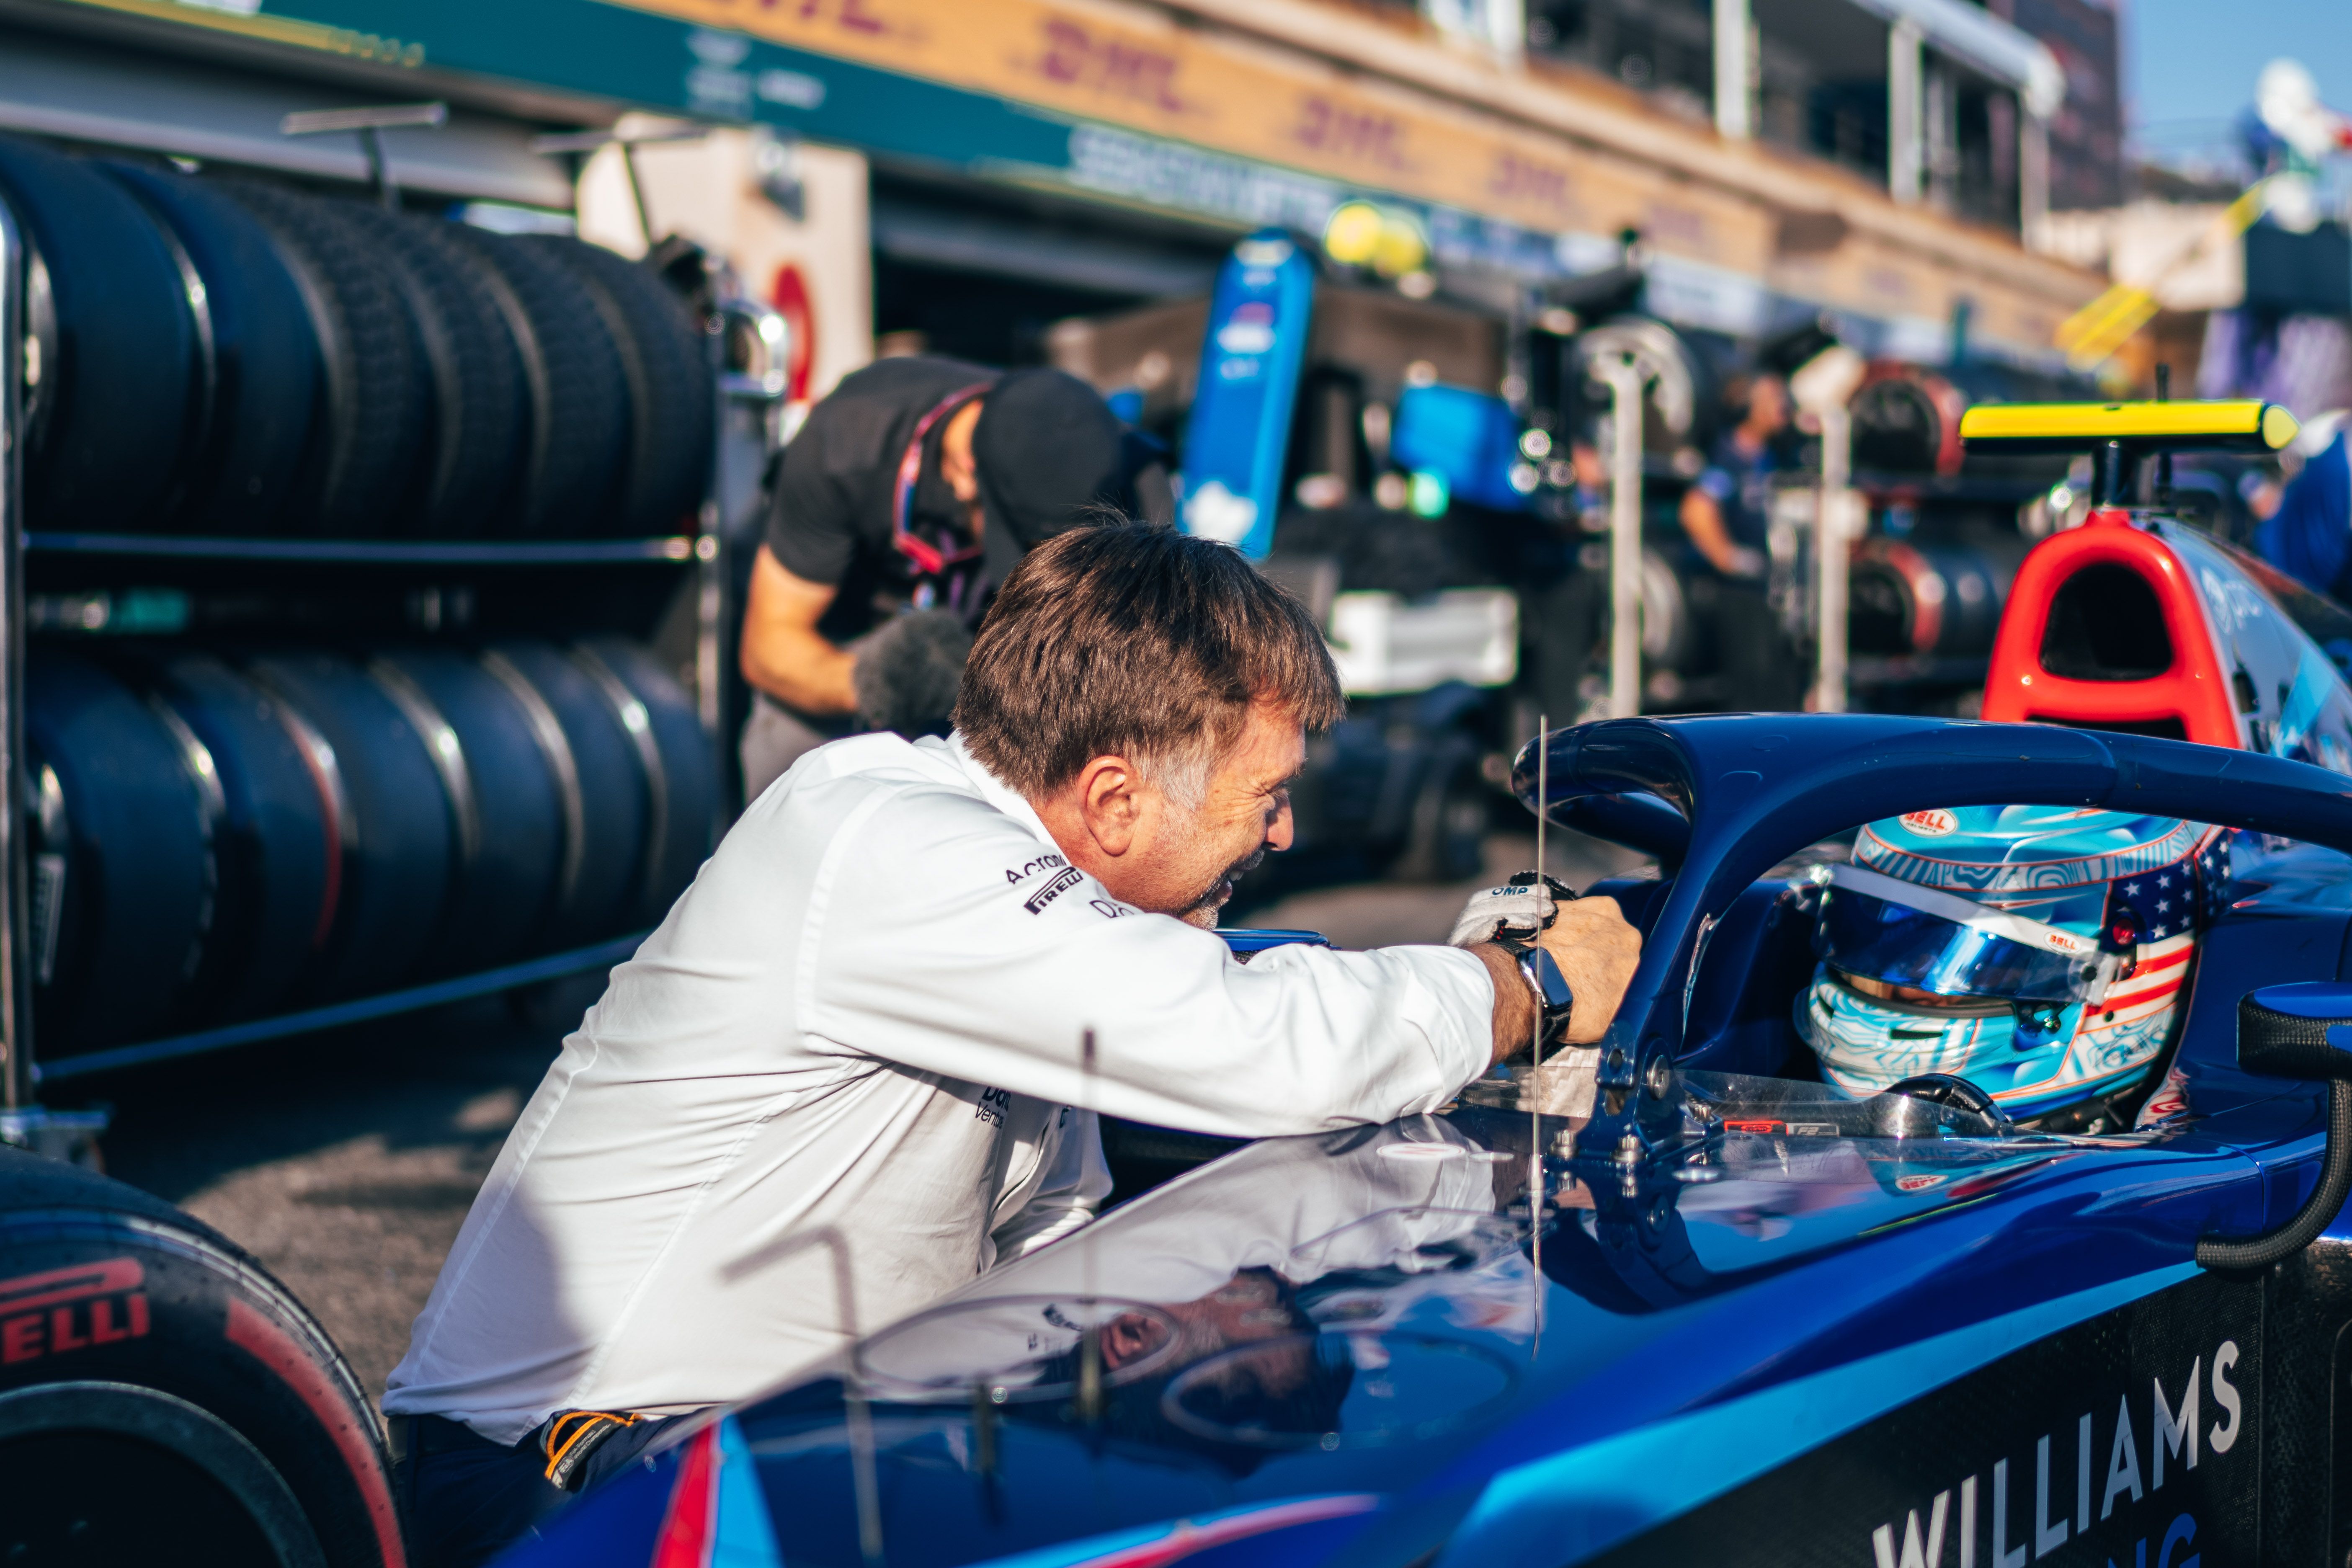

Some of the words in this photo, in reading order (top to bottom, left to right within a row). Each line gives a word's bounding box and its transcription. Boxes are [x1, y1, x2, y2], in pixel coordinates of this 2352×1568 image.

[1023, 866, 1084, 916] PIRELLI
[1492, 886, 1528, 896] OMP
[2050, 934, 2076, 950] BELL
[1872, 1341, 2241, 1568] WILLIAMS
